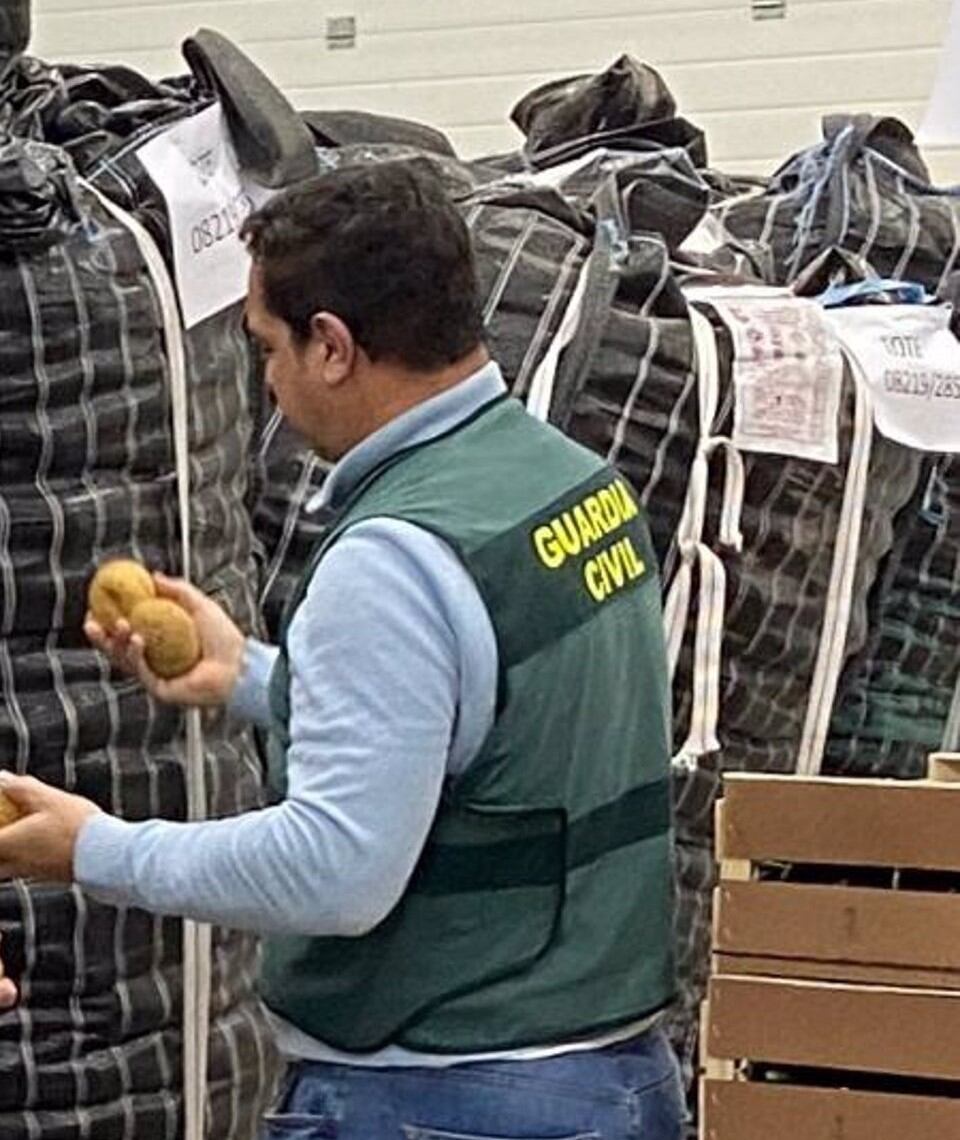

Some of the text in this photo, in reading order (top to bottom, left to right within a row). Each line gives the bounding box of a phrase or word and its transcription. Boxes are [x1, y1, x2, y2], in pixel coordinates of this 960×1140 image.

[191, 202, 241, 253] 0821
[533, 477, 639, 568] GUARDIA
[583, 536, 646, 602] CIVIL
